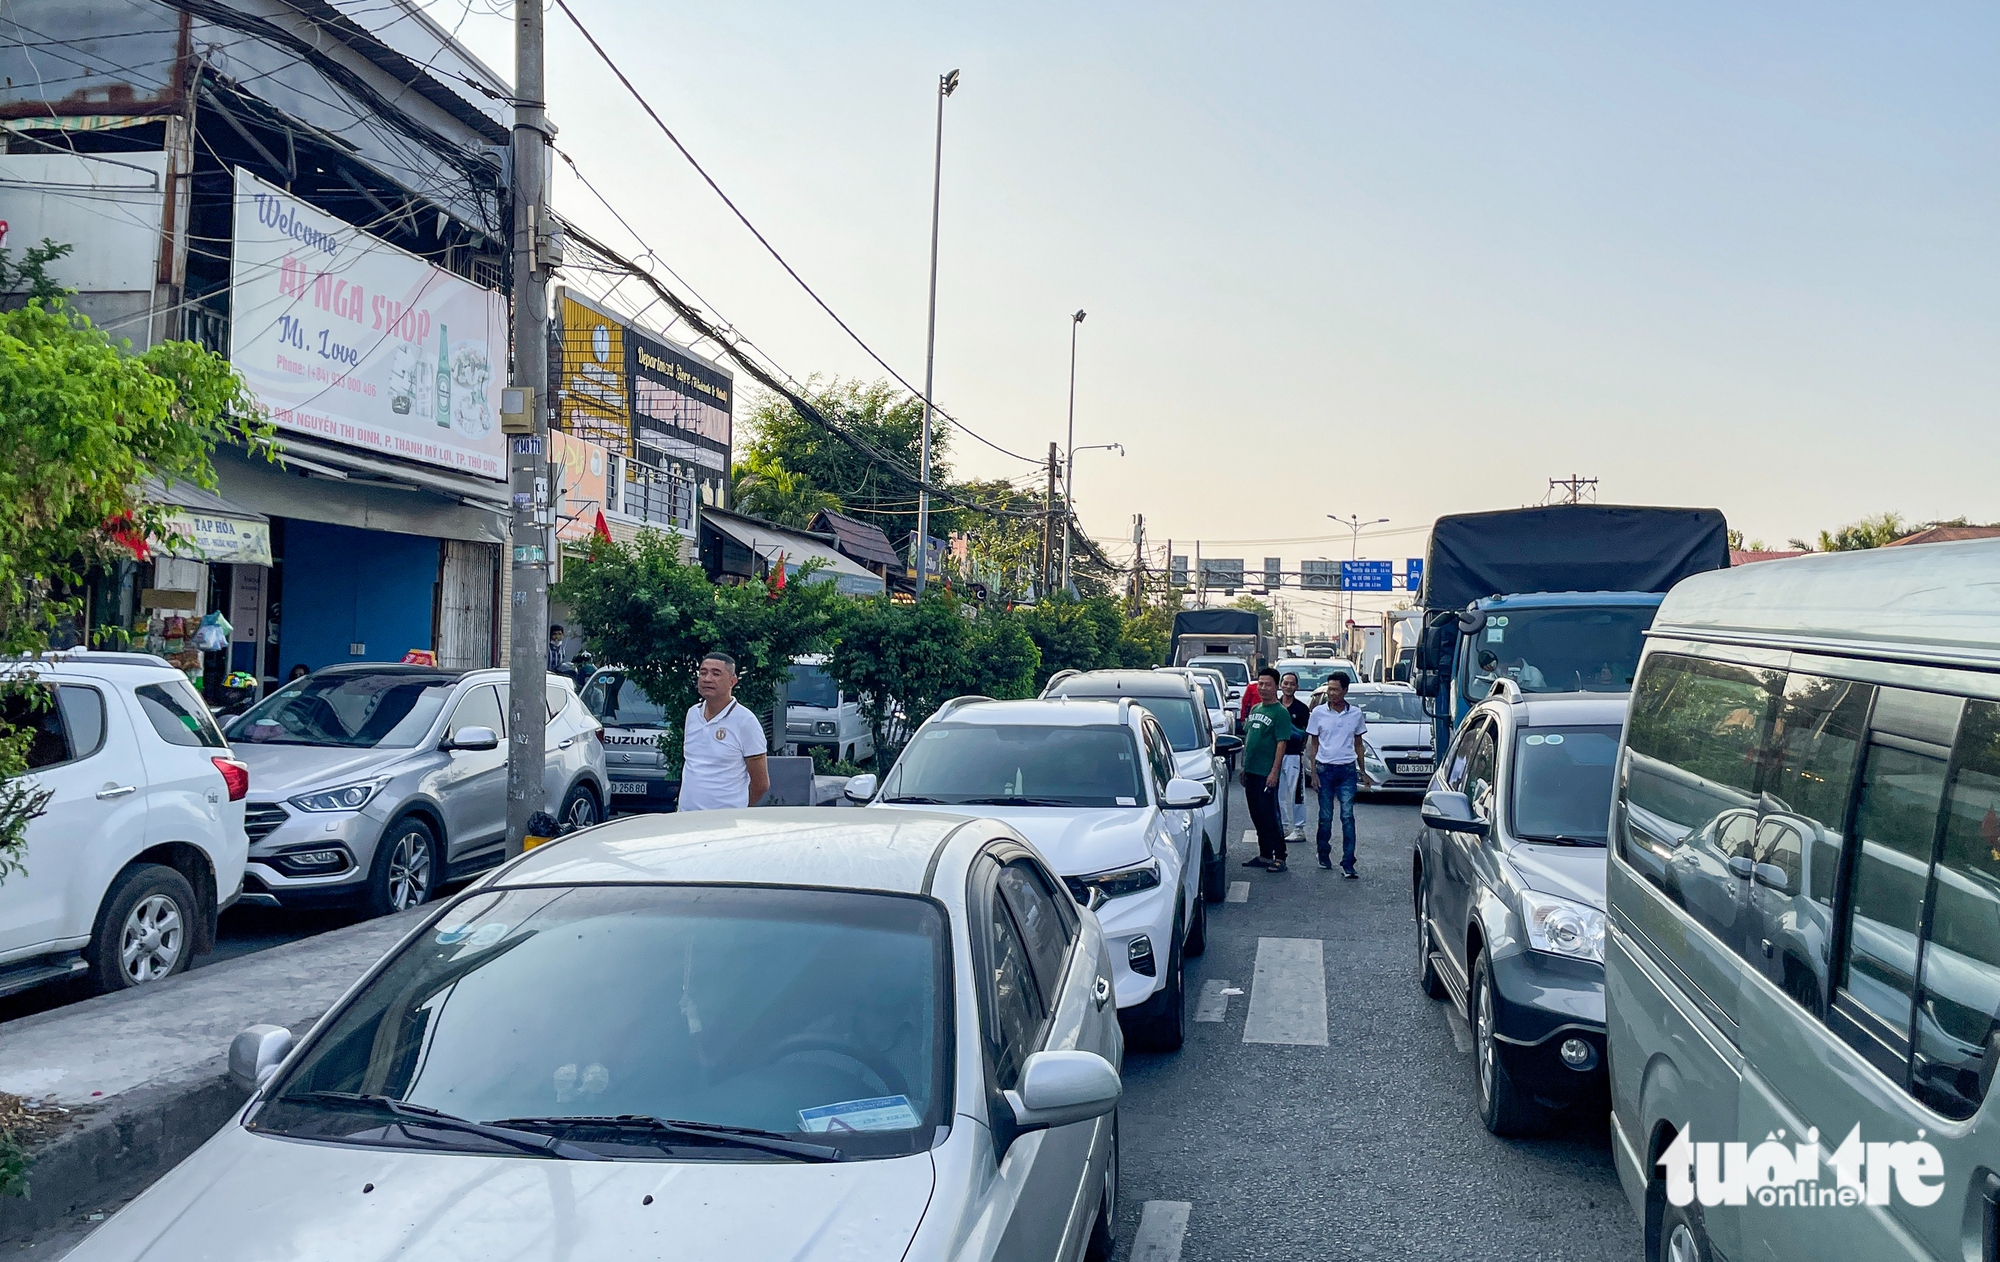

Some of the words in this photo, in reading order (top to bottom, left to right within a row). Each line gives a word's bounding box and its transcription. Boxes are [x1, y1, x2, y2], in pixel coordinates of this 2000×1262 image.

[254, 192, 337, 257] Welcome
[314, 269, 364, 325] NGA
[371, 294, 431, 346] SHOP
[278, 315, 310, 352] Ms.
[317, 329, 359, 367] Love
[276, 354, 306, 376] Phone:
[297, 415, 337, 435] NGUYỄN
[339, 423, 355, 442] THỊ
[384, 434, 393, 449] P.
[394, 437, 423, 456] THẠNH
[194, 518, 213, 535] TẠP
[604, 735, 654, 746] SUZUKI
